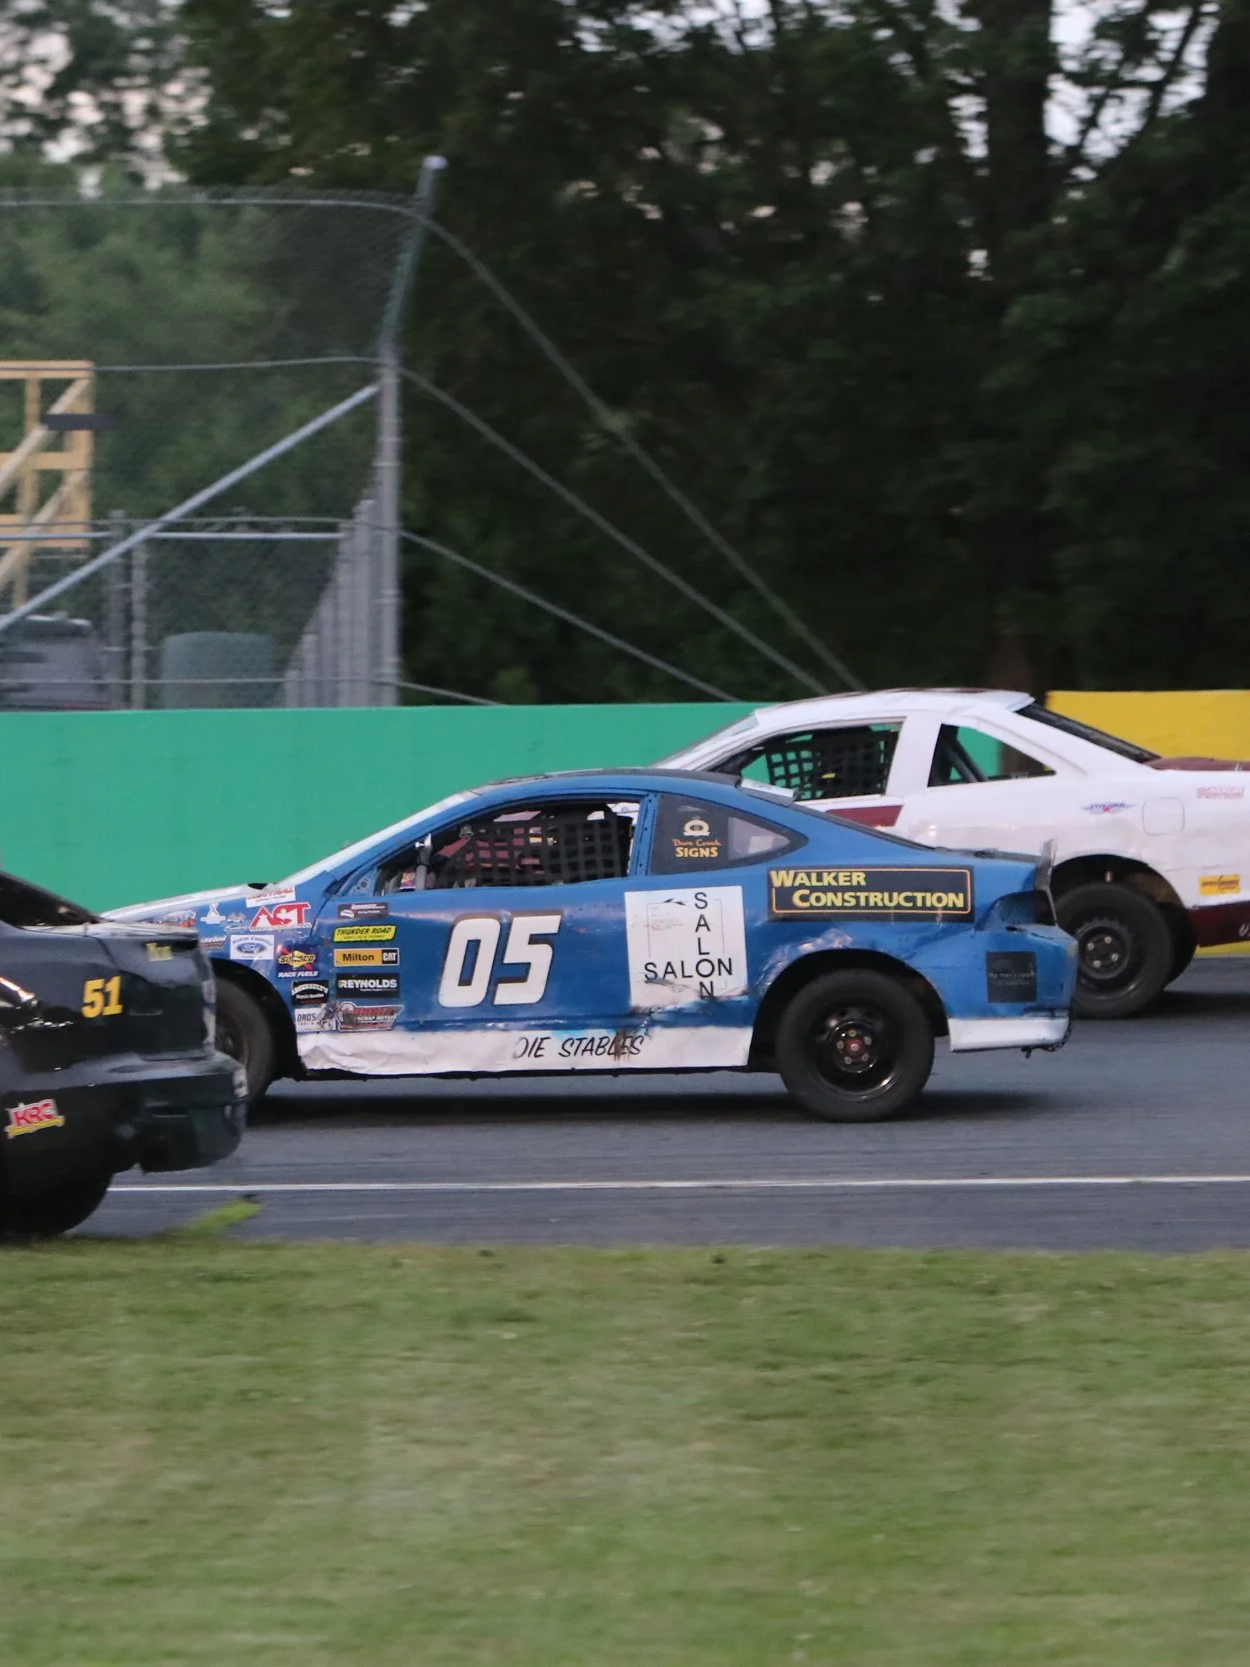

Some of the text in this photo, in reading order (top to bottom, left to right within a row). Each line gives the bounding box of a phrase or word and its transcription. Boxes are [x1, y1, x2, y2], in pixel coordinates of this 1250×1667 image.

[676, 847, 718, 858] SIGNS
[770, 870, 866, 888] WALKER
[792, 889, 964, 908] CONSTRUCTION
[249, 903, 311, 931] ACT
[337, 928, 370, 936] THUNDER
[342, 952, 397, 961] Milton CAT
[438, 915, 563, 1008] 05
[644, 958, 733, 981] SALON
[338, 979, 398, 989] REYNOLDS
[81, 976, 124, 1018] 51
